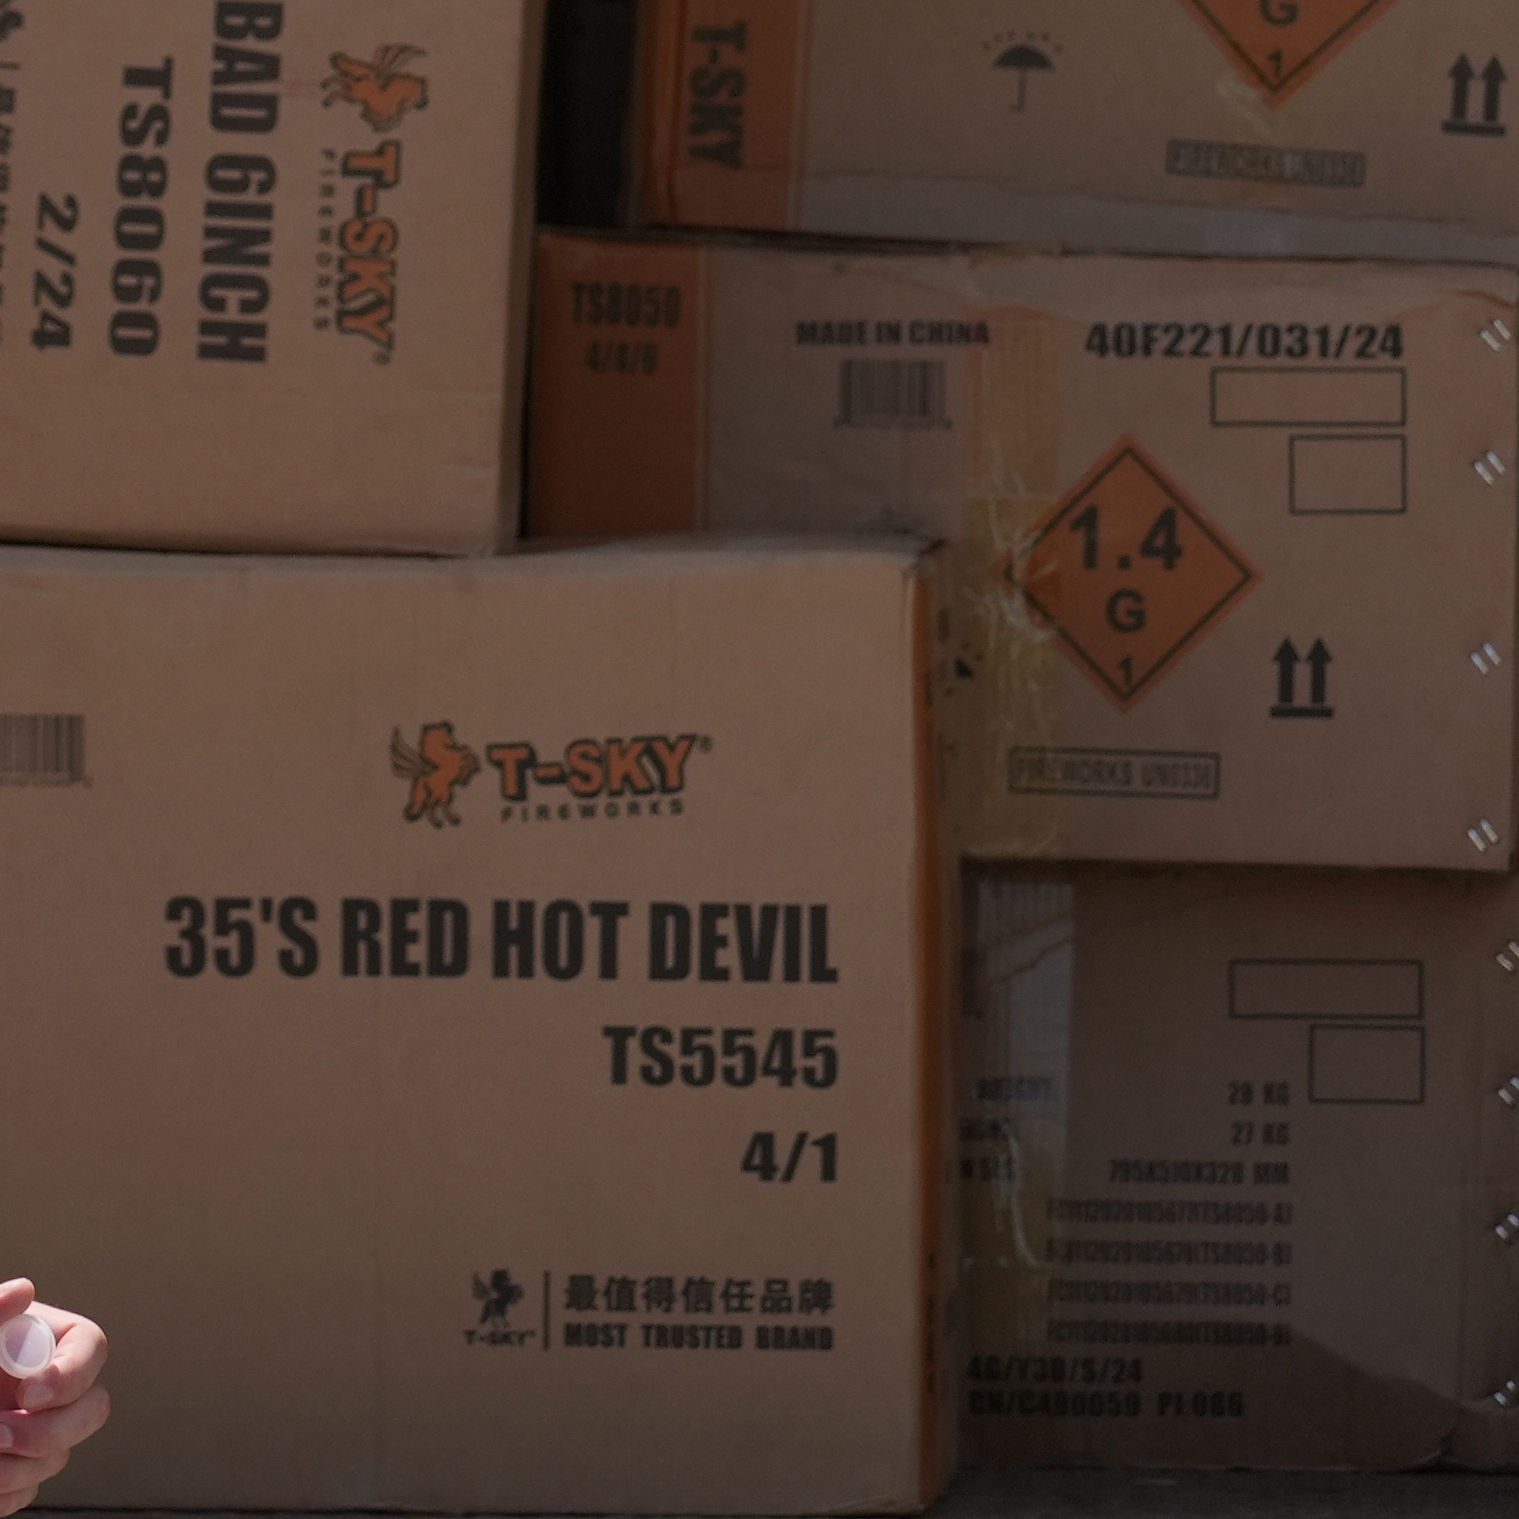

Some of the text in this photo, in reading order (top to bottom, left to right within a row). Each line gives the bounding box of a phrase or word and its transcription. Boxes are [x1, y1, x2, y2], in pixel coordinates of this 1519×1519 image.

[1267, 48, 1284, 77] 1
[687, 20, 747, 171] T-SKY
[107, 55, 174, 358] TS8060
[336, 138, 404, 348] T-SKY
[29, 191, 81, 352] 2/24
[795, 319, 991, 348] MADE IN CHINA
[1083, 322, 1405, 361] 40F221/031/24
[1069, 506, 1184, 573] 1.4
[1104, 589, 1147, 634] G
[1118, 655, 1135, 687] 1
[485, 732, 697, 803] T-SKY
[499, 798, 686, 825] FIREWORKS
[163, 894, 840, 984] 35'S RED HOT DEVIL
[601, 1024, 840, 1090] TS5545
[1263, 1080, 1291, 1106] KG
[1229, 1120, 1291, 1146] 27 KG
[739, 1130, 840, 1184] 4/1
[1252, 1160, 1291, 1185] MM
[563, 1272, 836, 1315] 最值得信任品牌
[563, 1322, 836, 1352] MOST TRUSTED BRAND
